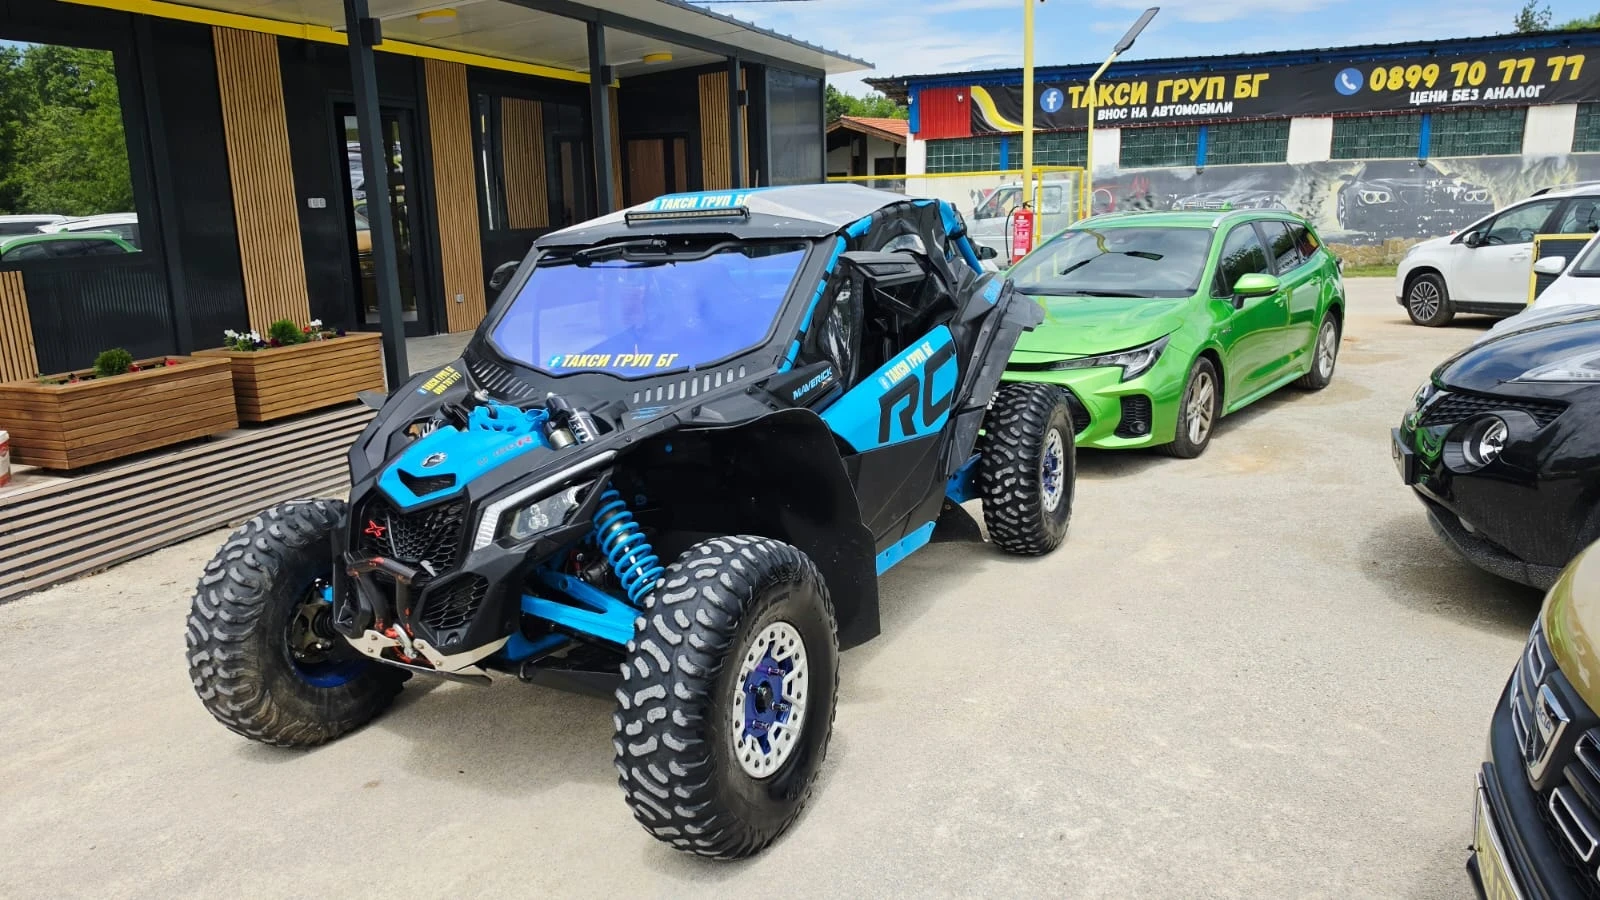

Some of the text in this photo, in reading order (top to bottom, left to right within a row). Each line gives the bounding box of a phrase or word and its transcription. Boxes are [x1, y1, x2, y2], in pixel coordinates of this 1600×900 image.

[1369, 54, 1585, 92] 0899 70 77 77
[1068, 81, 1148, 108] ТАКСИ
[1156, 77, 1225, 103] ГРУП
[1233, 73, 1269, 99] БГ
[1409, 84, 1545, 105] ЦЕНИ БЕЗ АНАЛОГ
[1097, 101, 1233, 121] ВНОС НА АВТОМОБИЛИ
[660, 195, 699, 210] ТАКСИ
[700, 194, 731, 208] ГРУП
[561, 353, 612, 368] ТАКСИ
[613, 353, 654, 368] ГРУП
[655, 353, 679, 368] БГ
[793, 366, 832, 400] MAVERICK
[878, 339, 956, 444] RC
